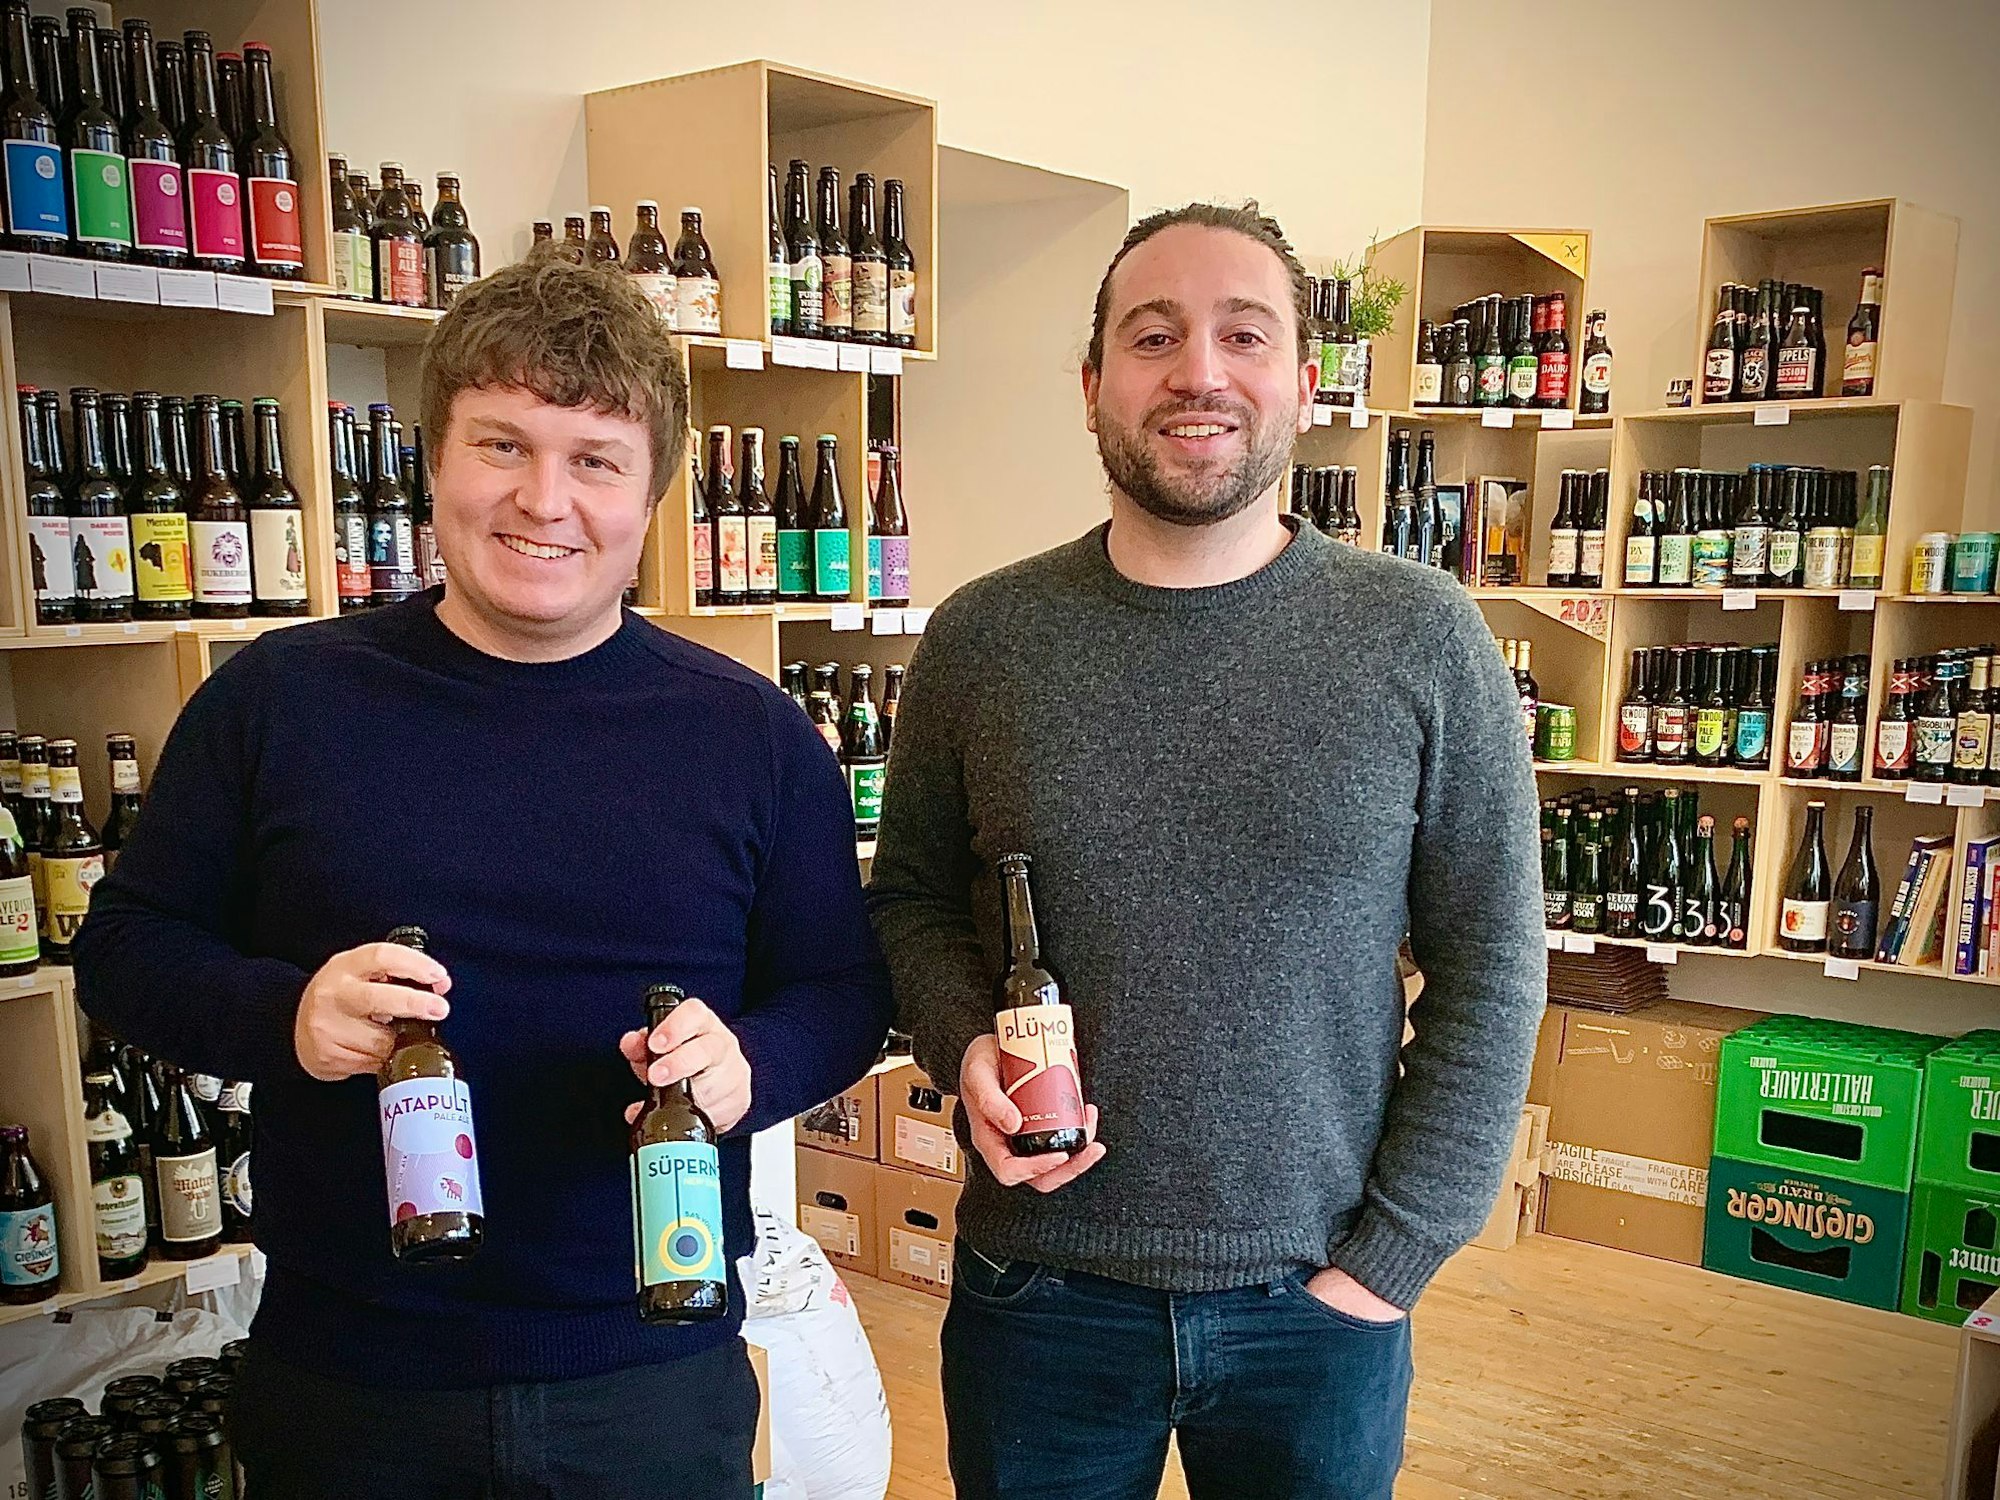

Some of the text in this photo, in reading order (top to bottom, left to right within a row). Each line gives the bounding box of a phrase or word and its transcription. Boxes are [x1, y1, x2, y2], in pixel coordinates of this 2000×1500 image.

[1596, 366, 1607, 380] T
[1607, 892, 1638, 904] GEUZE
[1607, 902, 1636, 912] BOON
[1643, 884, 1674, 935] 3
[1684, 899, 1705, 938] 3
[1718, 901, 1732, 939] 3
[16, 913, 29, 933] 2
[1005, 1017, 1068, 1041] PLÜMO
[1760, 1069, 1874, 1104] HALLERTAUER
[384, 1094, 468, 1121] KATAPULT
[433, 1111, 470, 1125] PALE ALE
[1580, 1161, 1623, 1179] PLEASE
[1647, 1177, 1668, 1187] WITH
[1670, 1177, 1706, 1195] CARE
[1648, 1163, 1685, 1179] FRAGILE
[1778, 1184, 1822, 1201] BRÄU
